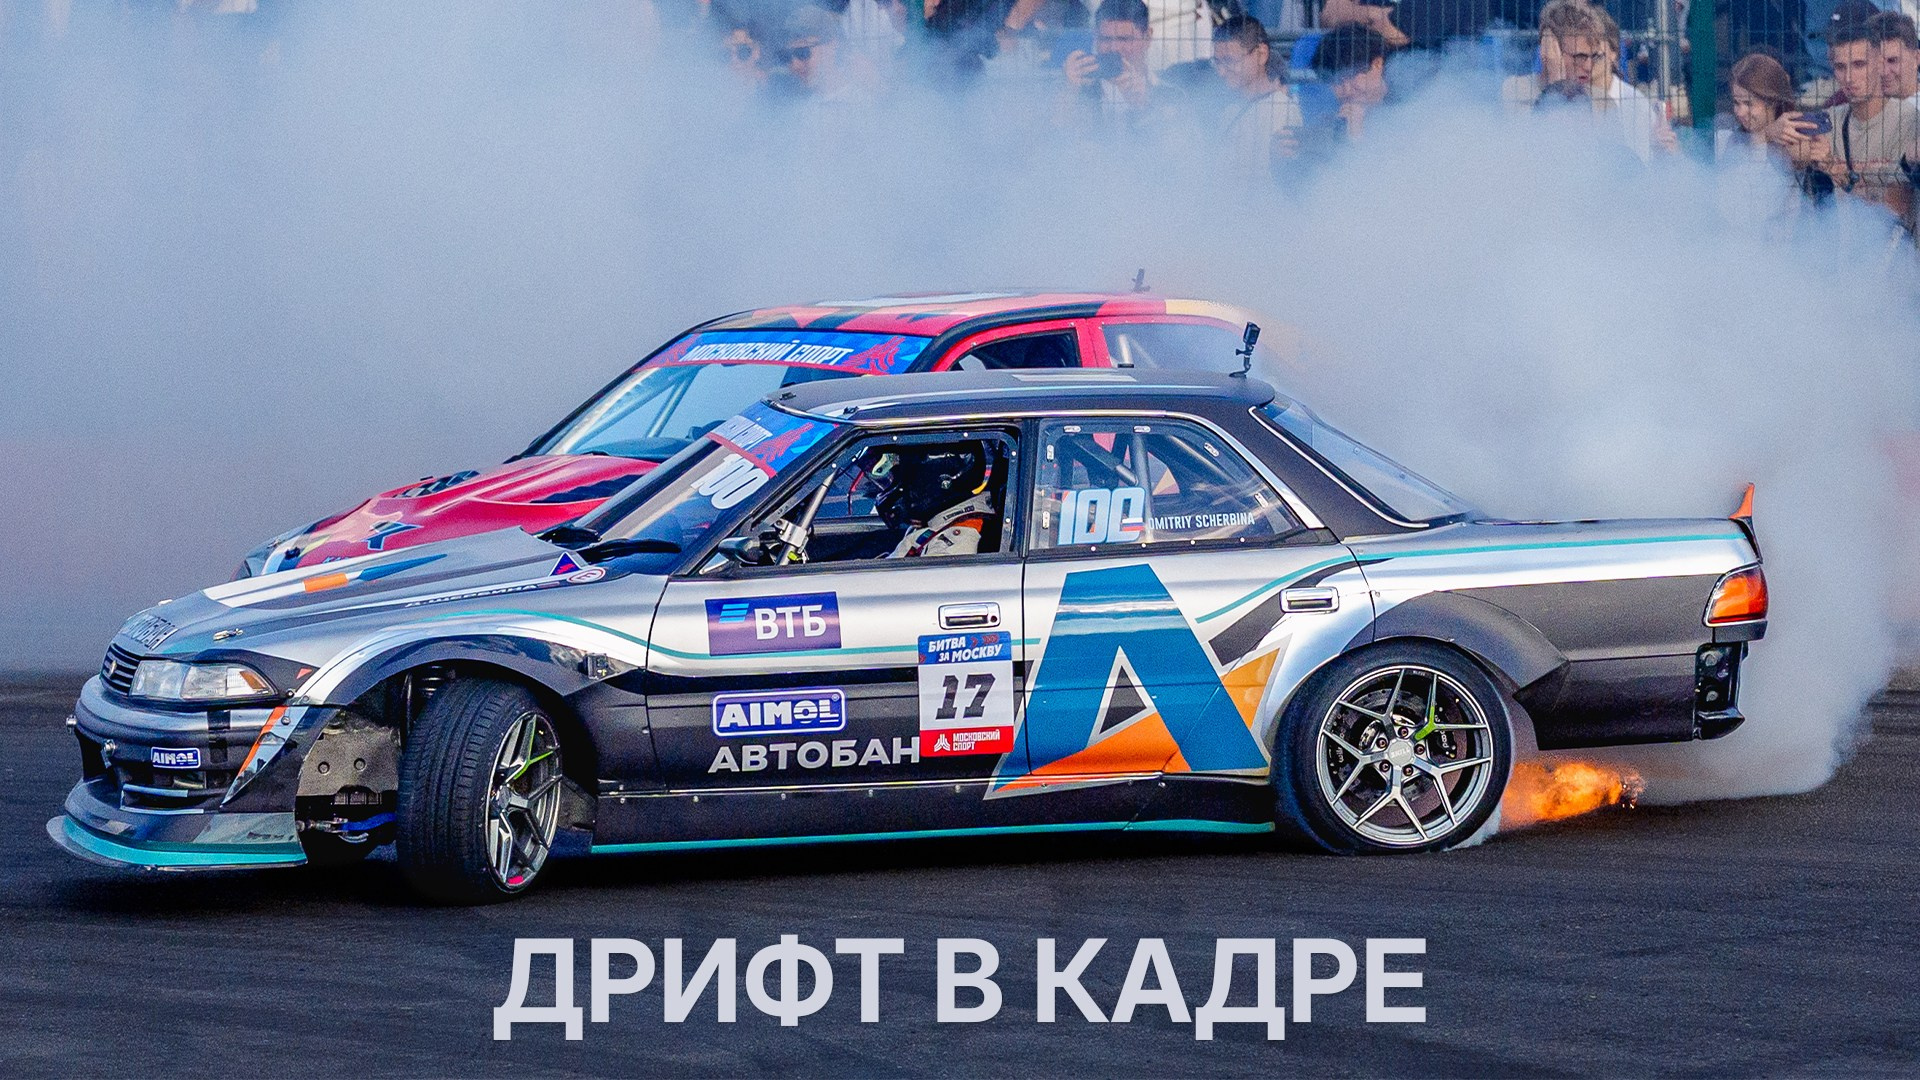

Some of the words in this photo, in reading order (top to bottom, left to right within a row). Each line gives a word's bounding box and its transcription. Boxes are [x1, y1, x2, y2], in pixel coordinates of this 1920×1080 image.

[785, 344, 854, 366] СПОРТ
[690, 453, 769, 510] 100
[1195, 512, 1255, 528] SCHERBINA
[754, 604, 827, 640] ВТБ
[928, 636, 966, 653] БИТВА
[938, 652, 950, 662] ЗА
[951, 644, 1003, 663] МОСКВУ
[935, 673, 996, 720] 17
[719, 698, 840, 728] AIMOL
[952, 728, 1001, 742] МОСКОВСКИЙ
[707, 736, 919, 774] АВТОБАН
[952, 741, 976, 751] СПОРТ
[152, 751, 197, 765] AIMOL
